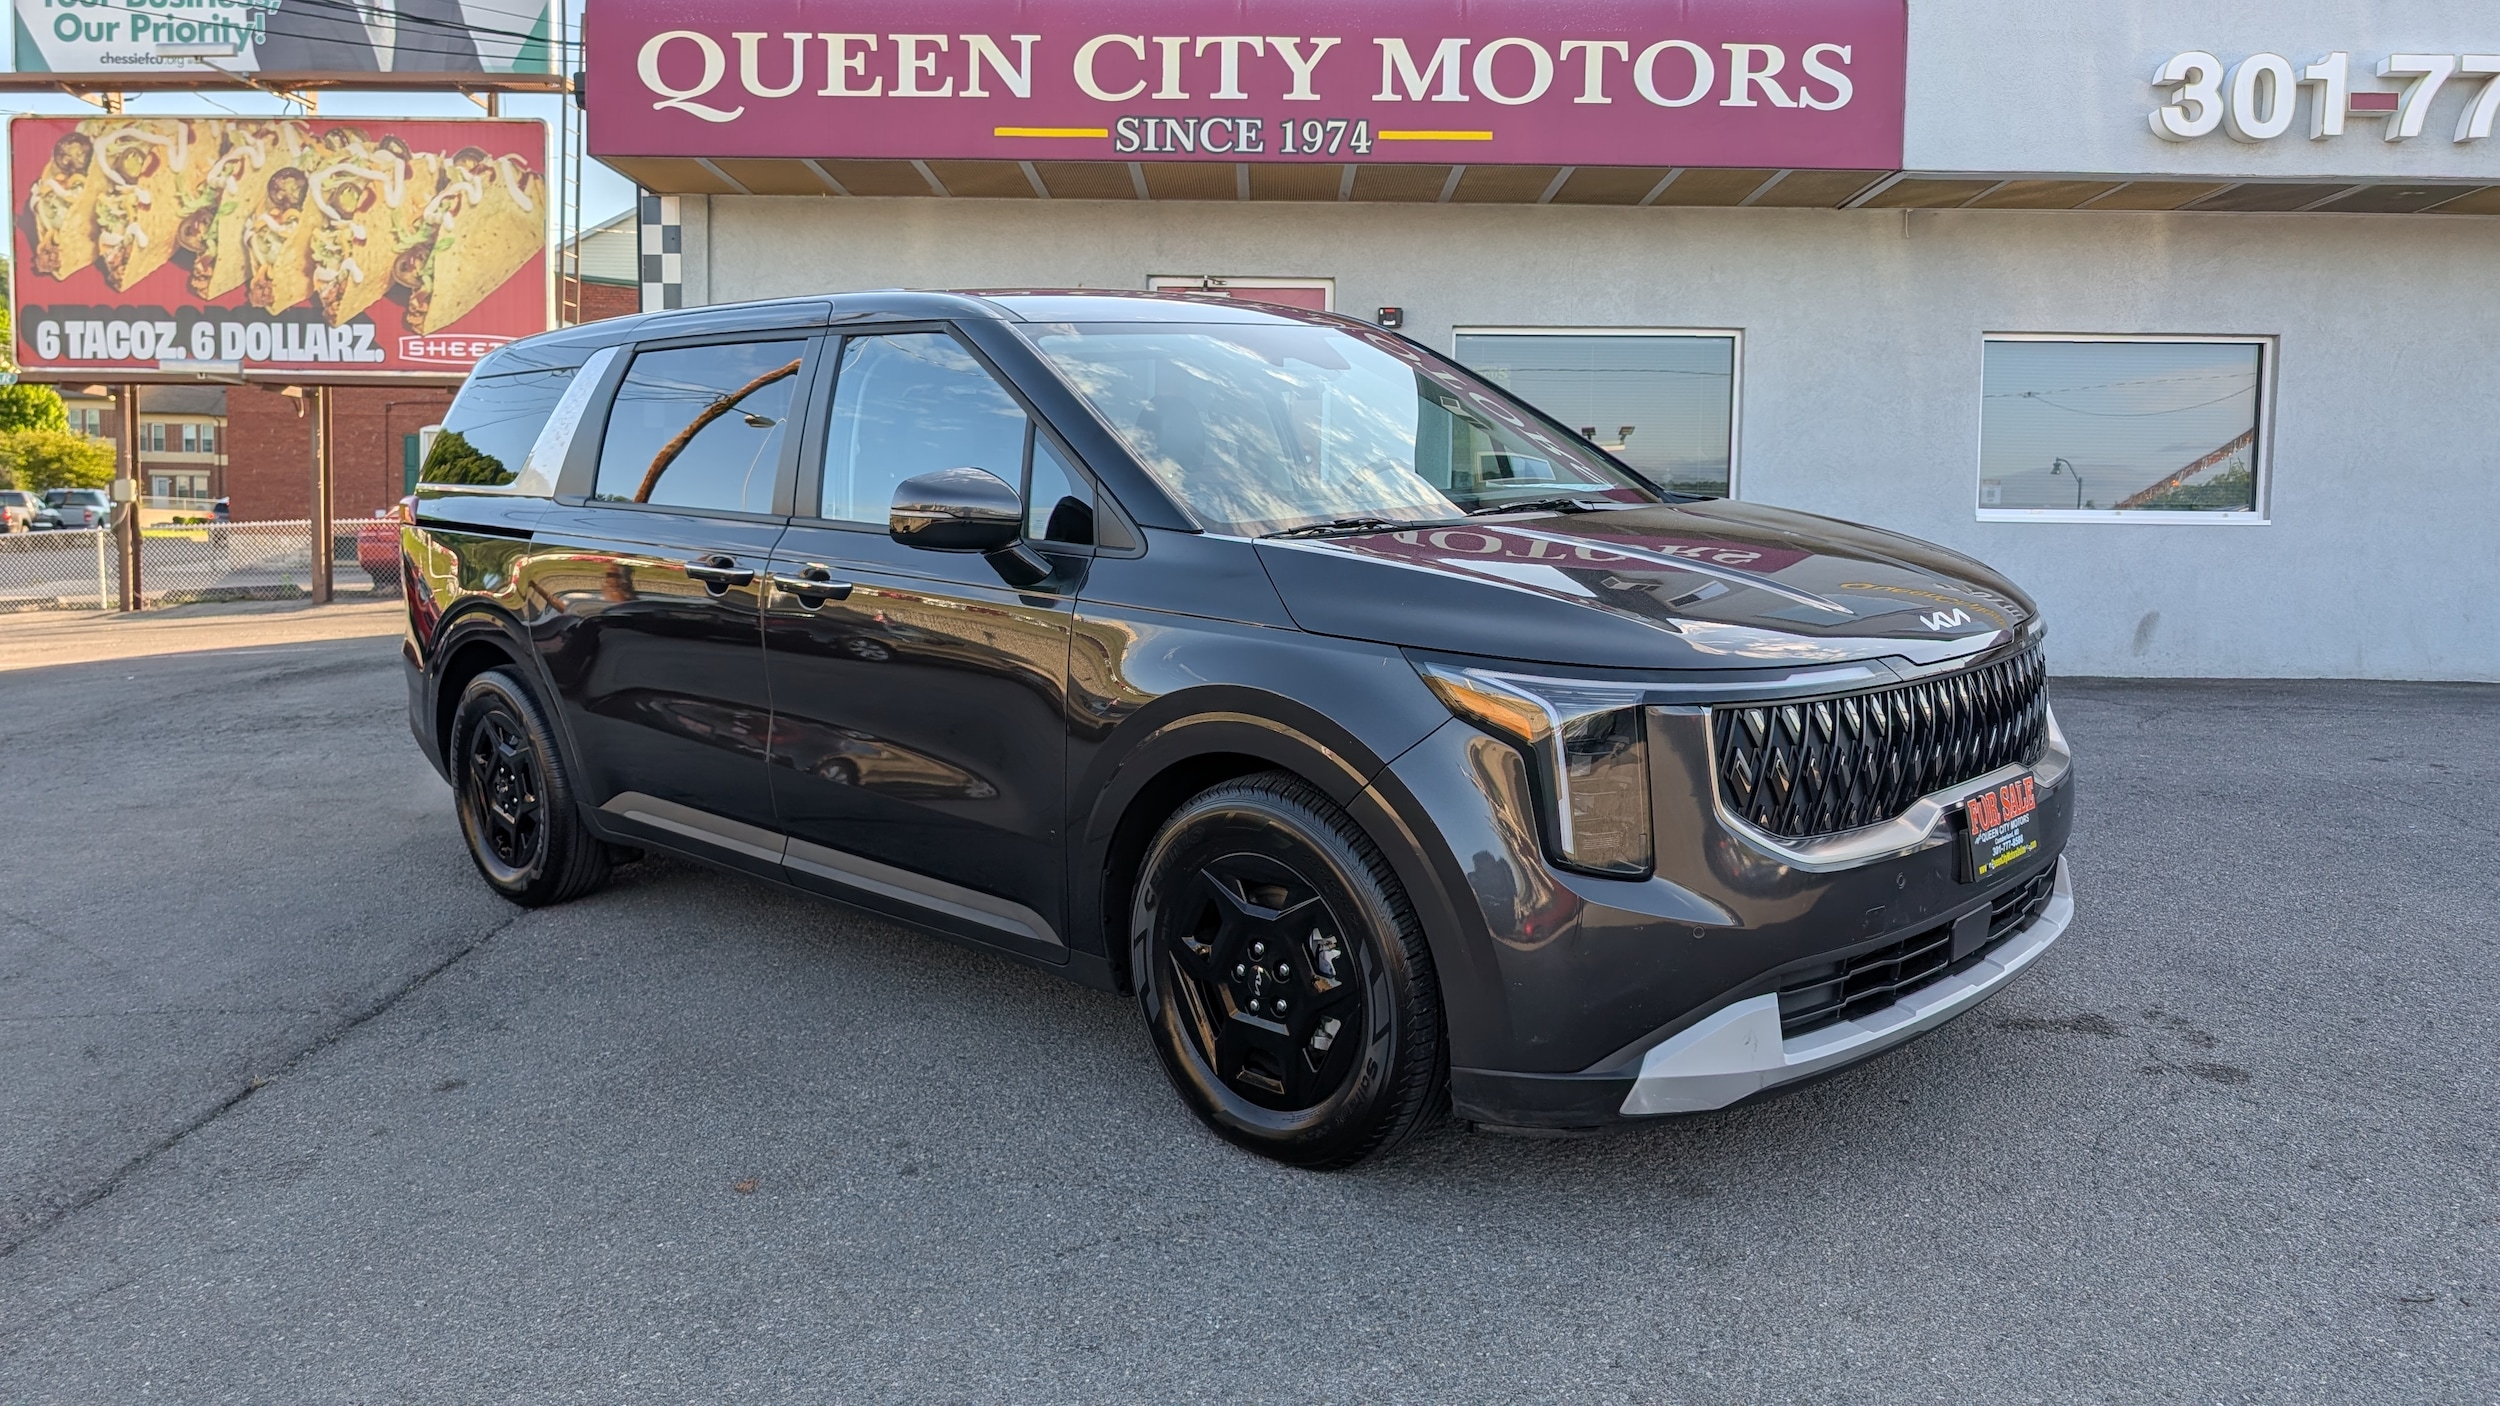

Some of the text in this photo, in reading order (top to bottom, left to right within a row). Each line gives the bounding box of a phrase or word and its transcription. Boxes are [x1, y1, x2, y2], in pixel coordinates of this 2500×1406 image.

[53, 12, 266, 52] Our Priority!
[636, 30, 1854, 123] QUEEN CITY MOTORS
[1115, 116, 1373, 155] SINCE 1974
[37, 320, 385, 363] 6 TACOZ. 6 DOLLARZ.
[1967, 776, 2036, 835] FOR SALE
